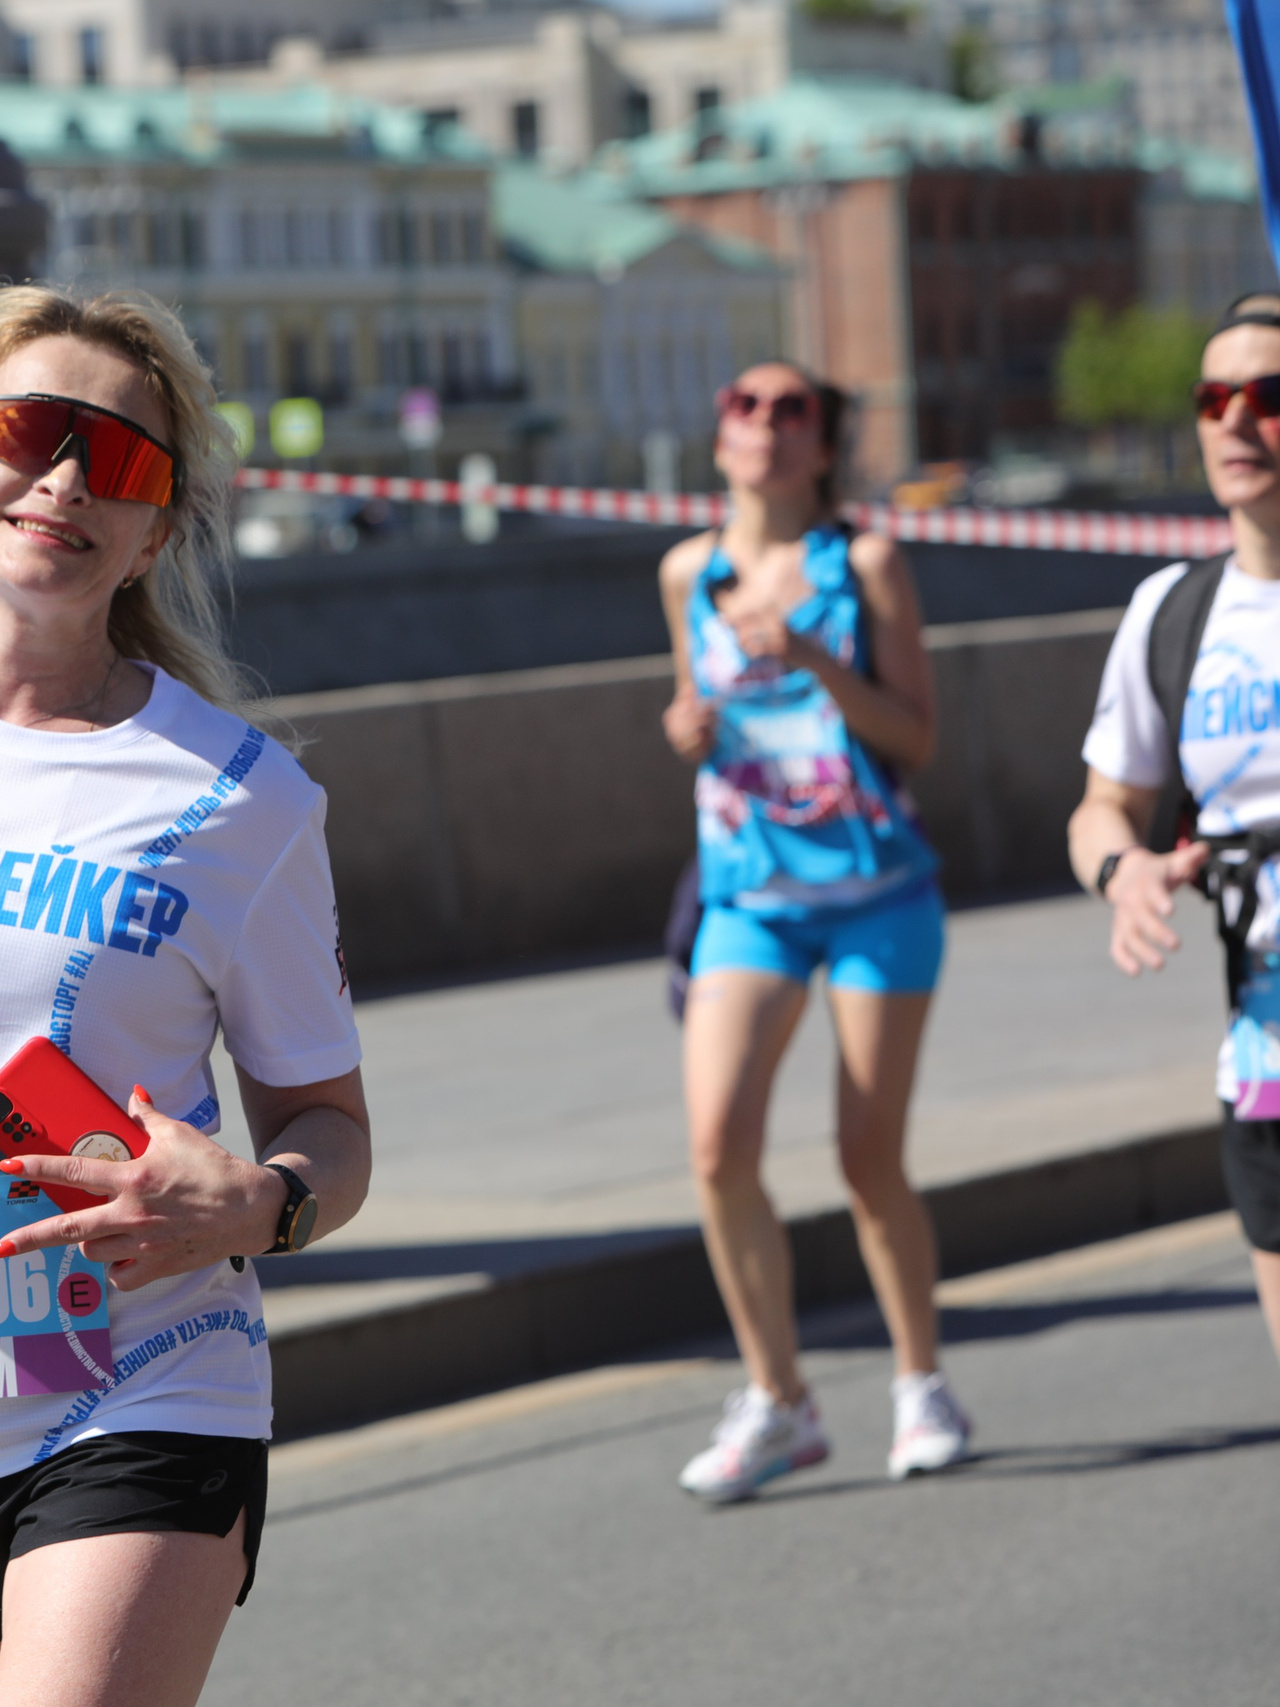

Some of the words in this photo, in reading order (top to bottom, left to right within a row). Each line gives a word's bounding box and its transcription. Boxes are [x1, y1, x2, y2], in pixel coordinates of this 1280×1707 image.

[174, 795, 221, 837] #ЦЕЛЬ
[6, 1198, 38, 1206] TORERO
[175, 1309, 231, 1344] #МЕЧТА
